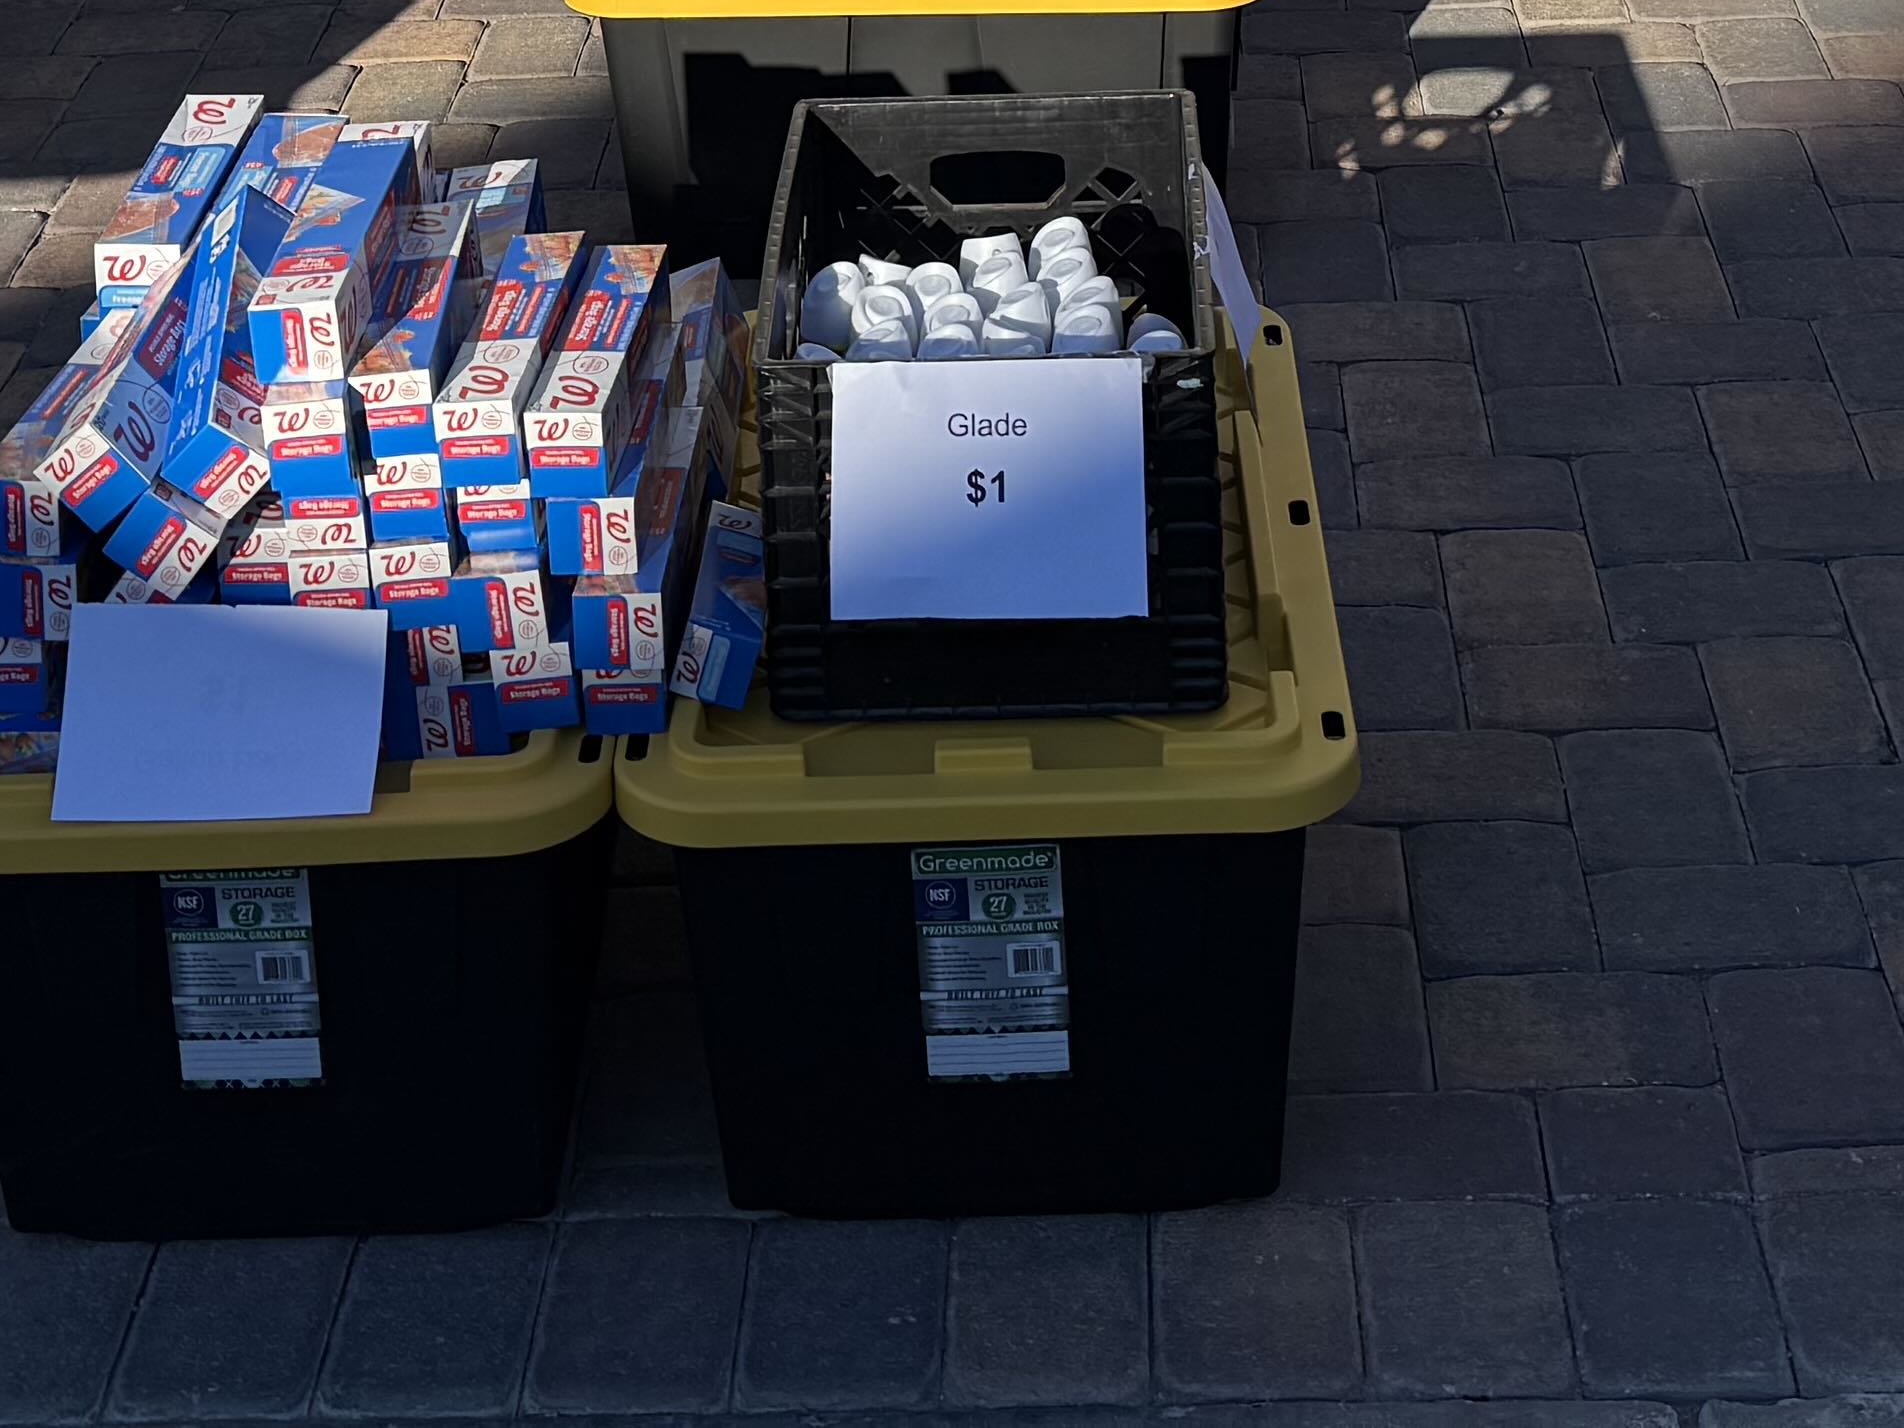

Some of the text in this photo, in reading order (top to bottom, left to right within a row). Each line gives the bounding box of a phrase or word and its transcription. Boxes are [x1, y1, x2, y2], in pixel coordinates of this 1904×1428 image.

[368, 413, 419, 427] Storage Bags
[947, 412, 1028, 440] Glade
[280, 443, 335, 457] Storage Bags
[450, 443, 501, 455] Storage Bags
[539, 453, 591, 465] Storage Bags
[71, 458, 113, 501] Storage Bags
[966, 469, 1006, 507] $1
[380, 496, 431, 510] Storage Bags
[467, 507, 518, 520] Storage Bags
[388, 586, 440, 601] Storage Bags
[305, 595, 358, 607] Storage Bags
[510, 686, 561, 700] Storage Bags
[919, 850, 1049, 872] Greenmade
[974, 876, 1049, 891] STORAGE
[221, 887, 296, 900] STORAGE
[929, 888, 951, 902] NSF
[177, 896, 199, 910] NSF
[988, 895, 1008, 912] 27
[236, 904, 254, 921] 27
[922, 920, 1059, 936] PROFESSIONAL GRADE BOX
[171, 929, 308, 943] PROFESSIONAL GRADE BOX
